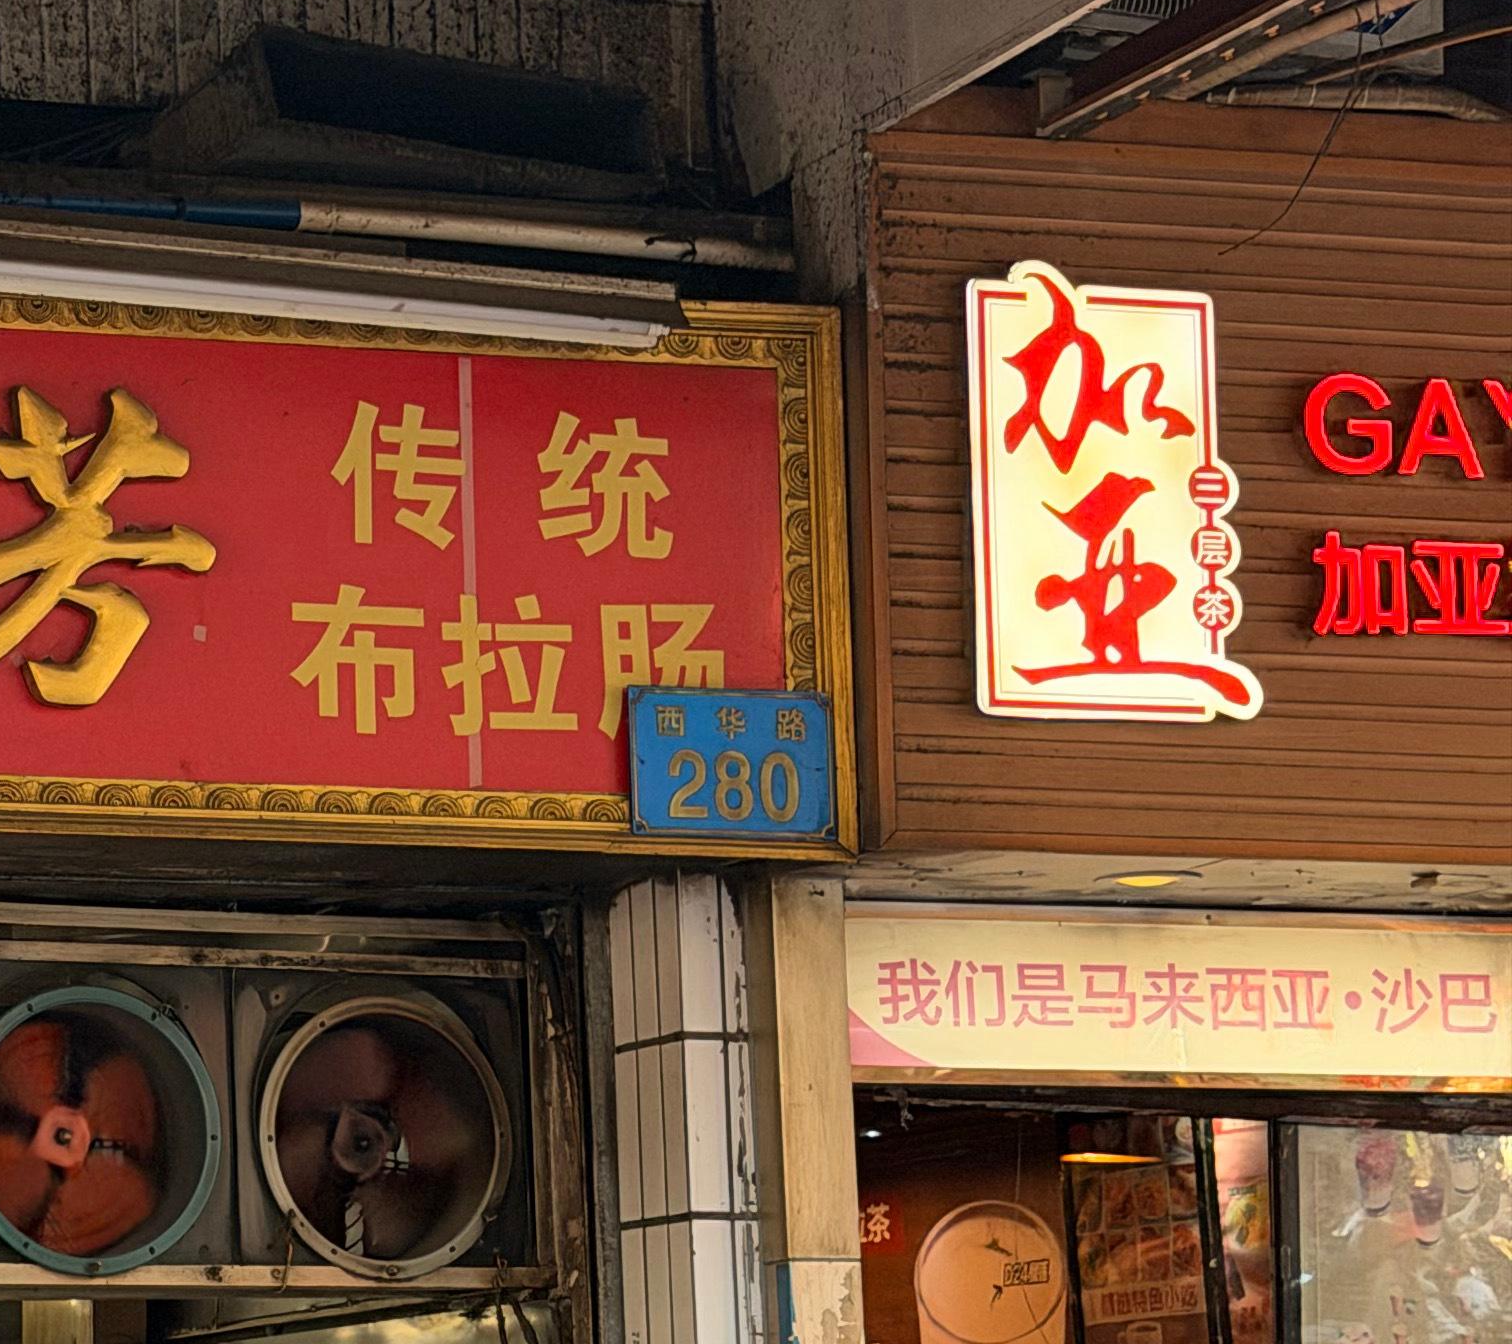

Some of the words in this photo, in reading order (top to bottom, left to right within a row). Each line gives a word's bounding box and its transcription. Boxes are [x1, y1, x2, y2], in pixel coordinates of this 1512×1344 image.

[332, 400, 675, 560] 传统
[1192, 472, 1231, 626] 三层茶
[290, 584, 725, 740] 布拉肠
[656, 706, 807, 741] 西华路
[668, 749, 801, 823] 280
